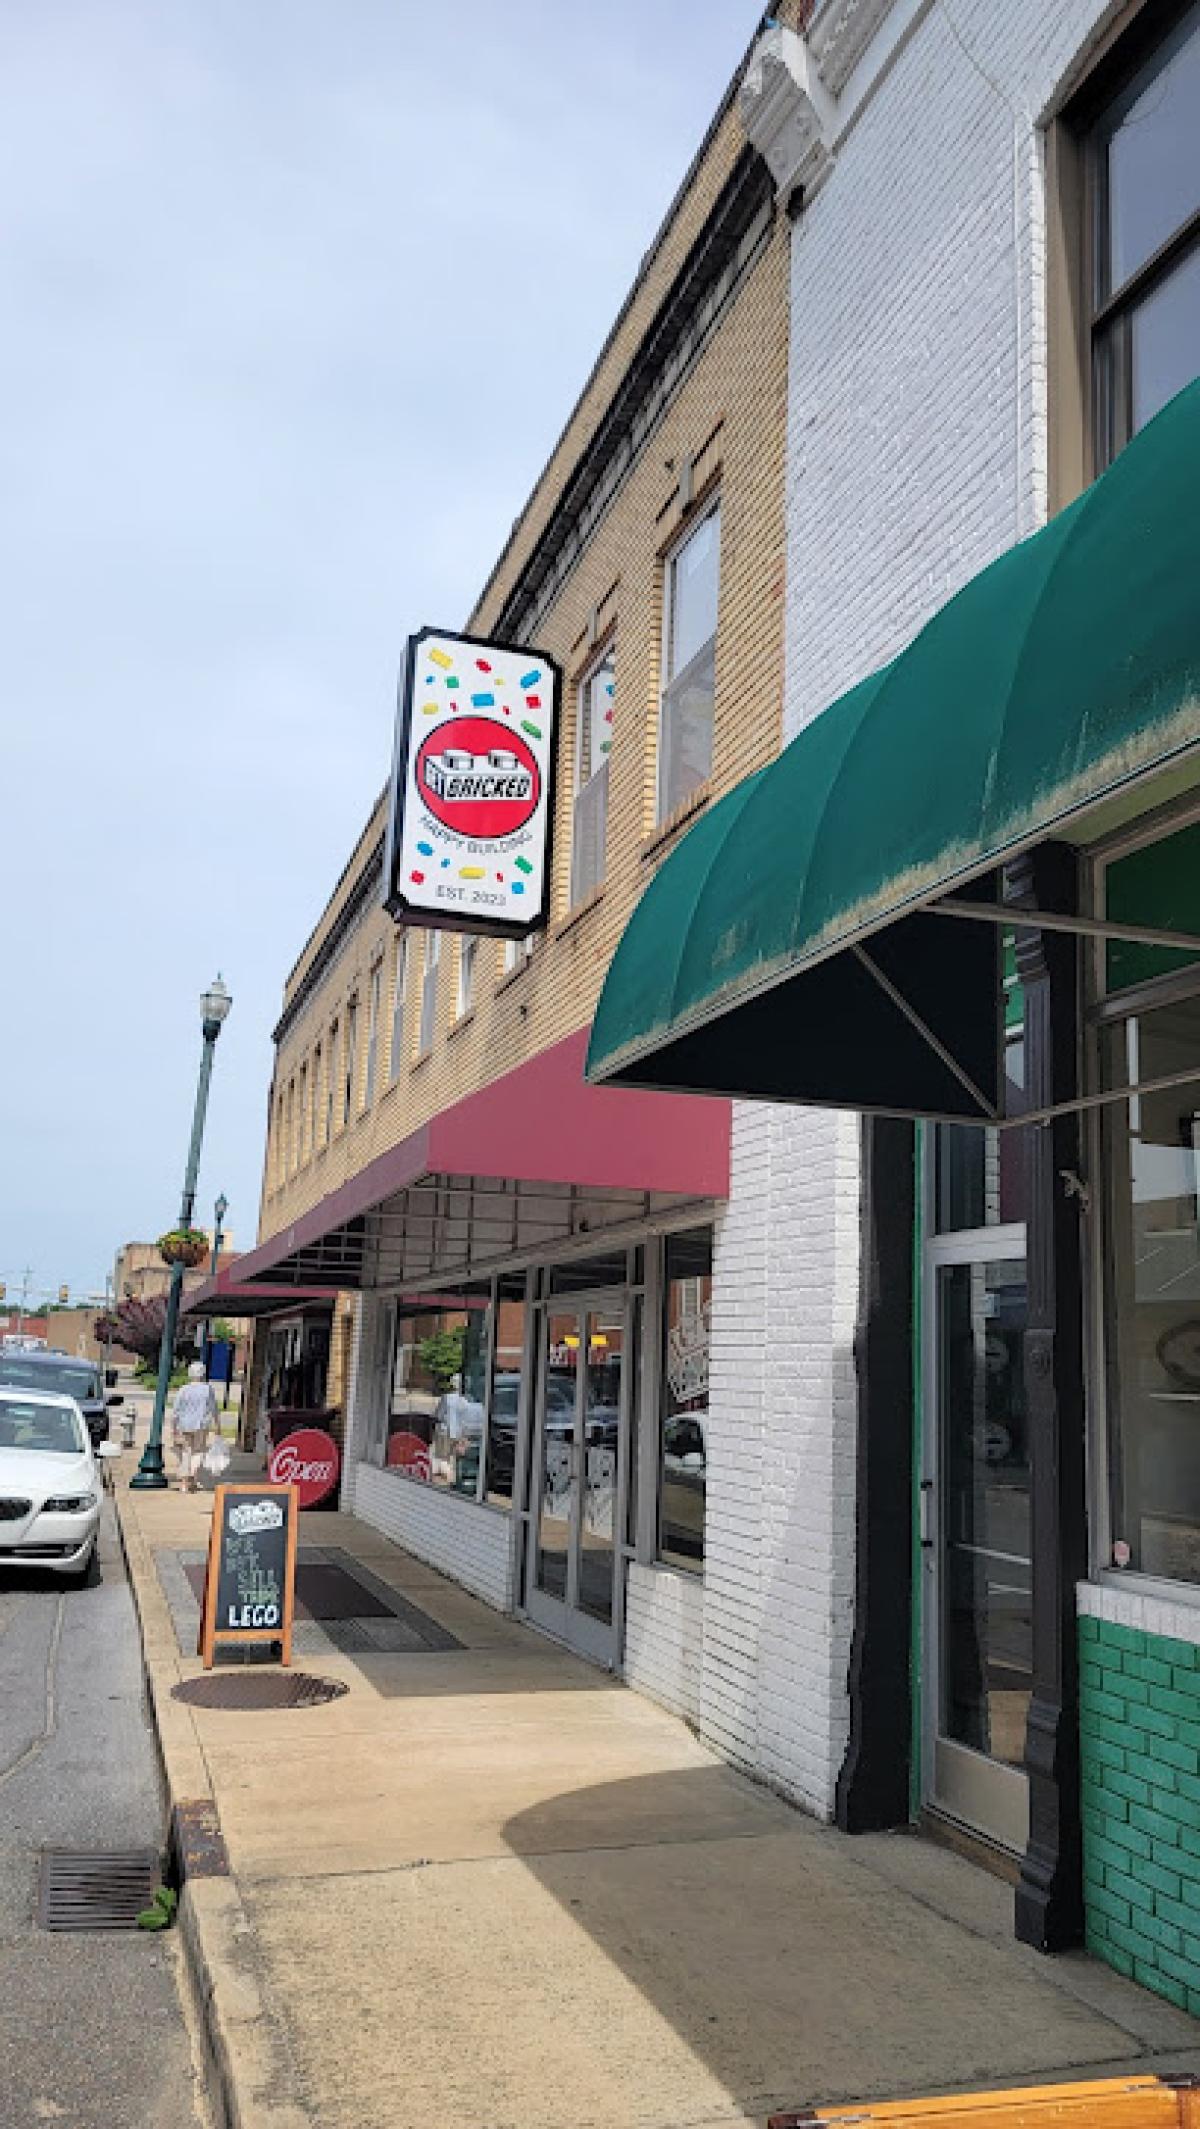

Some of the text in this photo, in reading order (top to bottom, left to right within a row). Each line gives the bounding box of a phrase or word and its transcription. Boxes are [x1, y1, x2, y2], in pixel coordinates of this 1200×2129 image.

[446, 776, 530, 799] BRICKED
[418, 815, 465, 850] HAPPY
[269, 1446, 334, 1486] Open
[228, 1604, 279, 1627] LEGO
